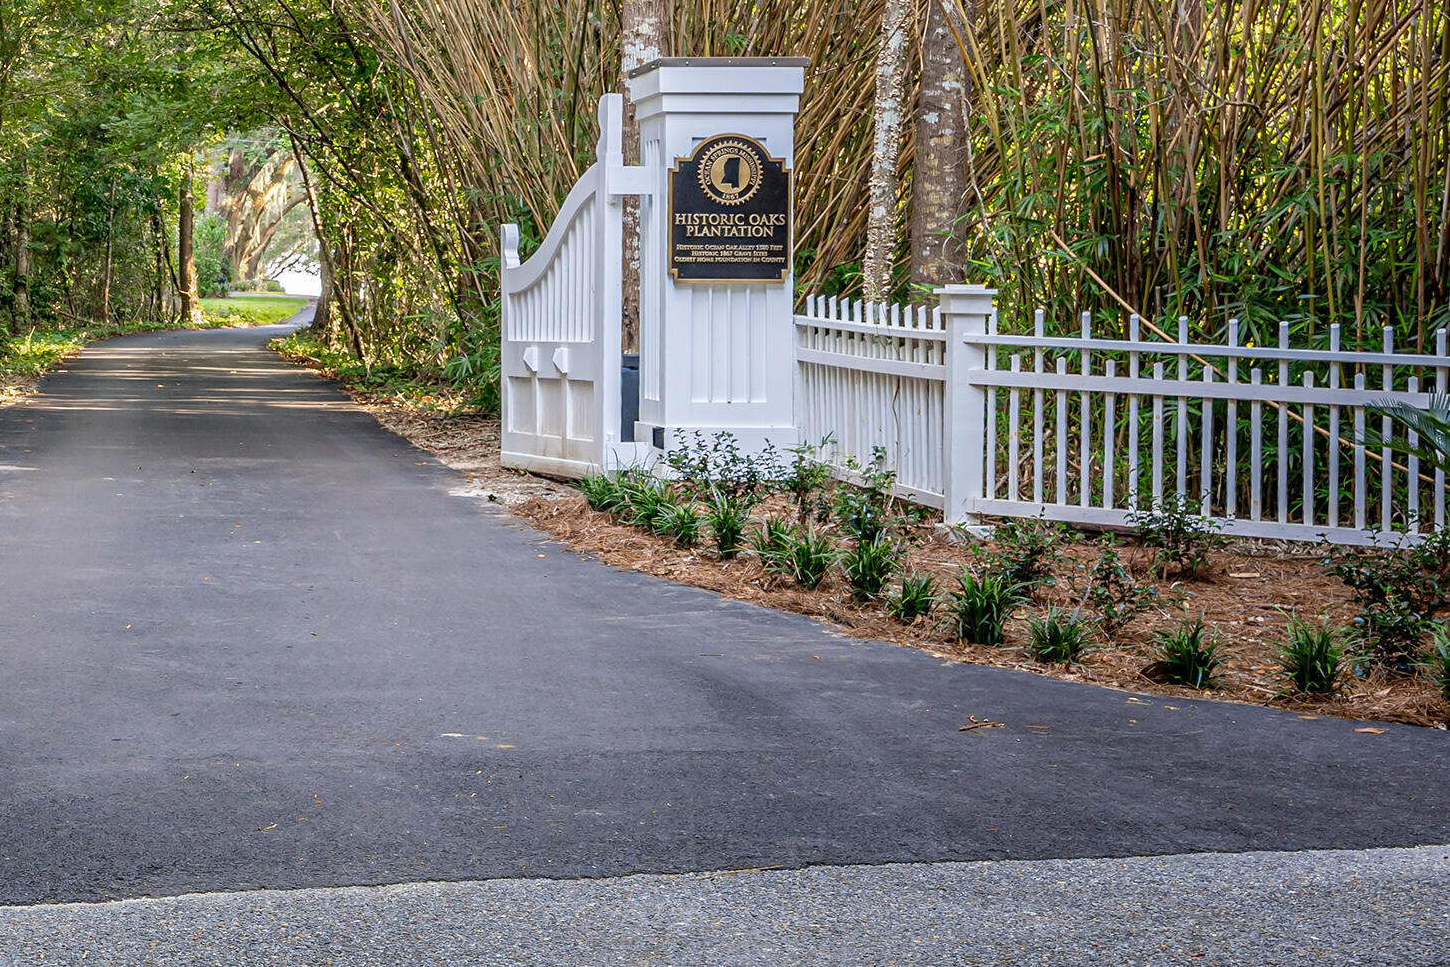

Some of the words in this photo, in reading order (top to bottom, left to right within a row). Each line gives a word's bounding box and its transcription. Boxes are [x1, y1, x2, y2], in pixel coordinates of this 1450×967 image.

[704, 159, 713, 185] OCEAN
[710, 147, 739, 161] SPRINGS
[674, 213, 745, 225] HISTORIC
[749, 213, 786, 225] OAKS
[686, 225, 775, 237] PLANTATION
